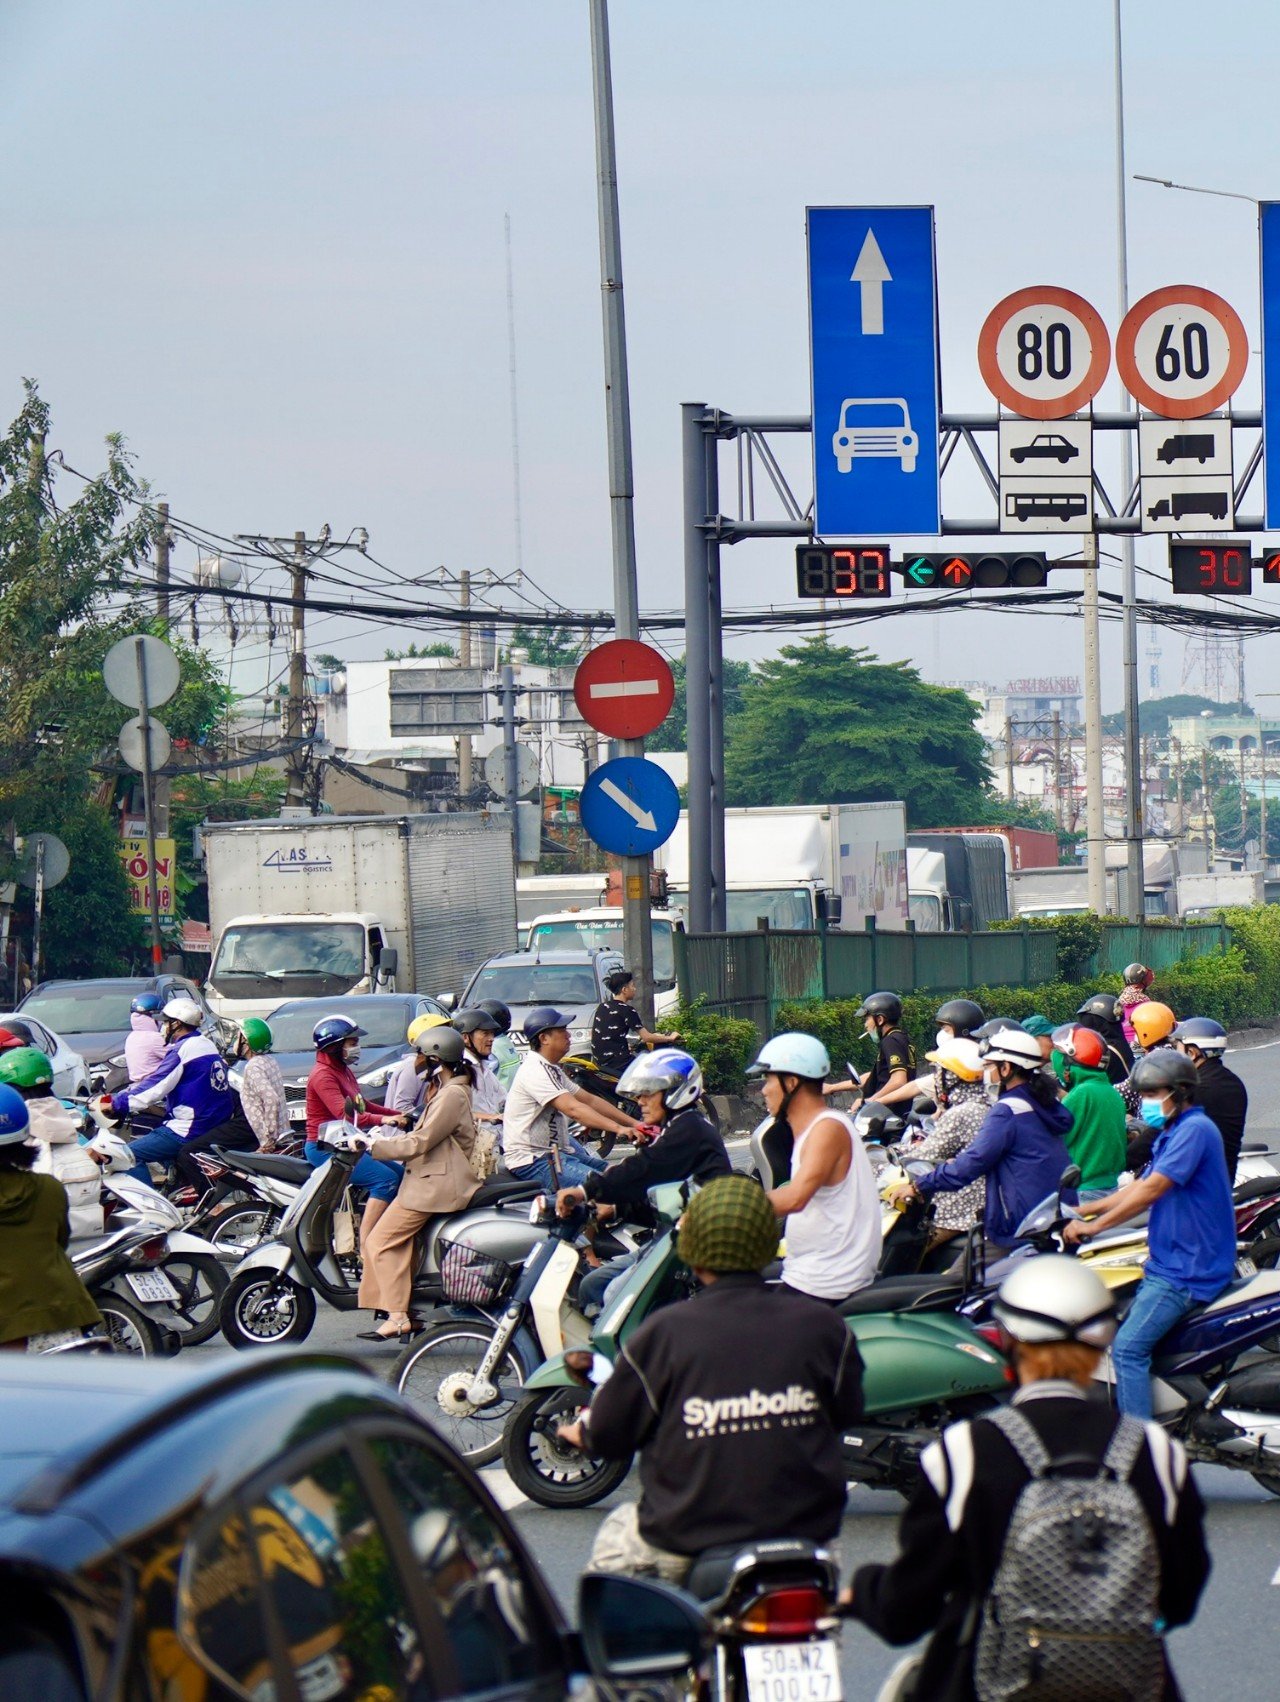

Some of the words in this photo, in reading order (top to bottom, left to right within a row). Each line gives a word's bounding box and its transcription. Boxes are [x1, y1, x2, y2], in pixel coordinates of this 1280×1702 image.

[1017, 322, 1072, 381] 80
[1155, 322, 1210, 382] 60
[1199, 549, 1243, 587] 30
[120, 852, 171, 880] ÓN
